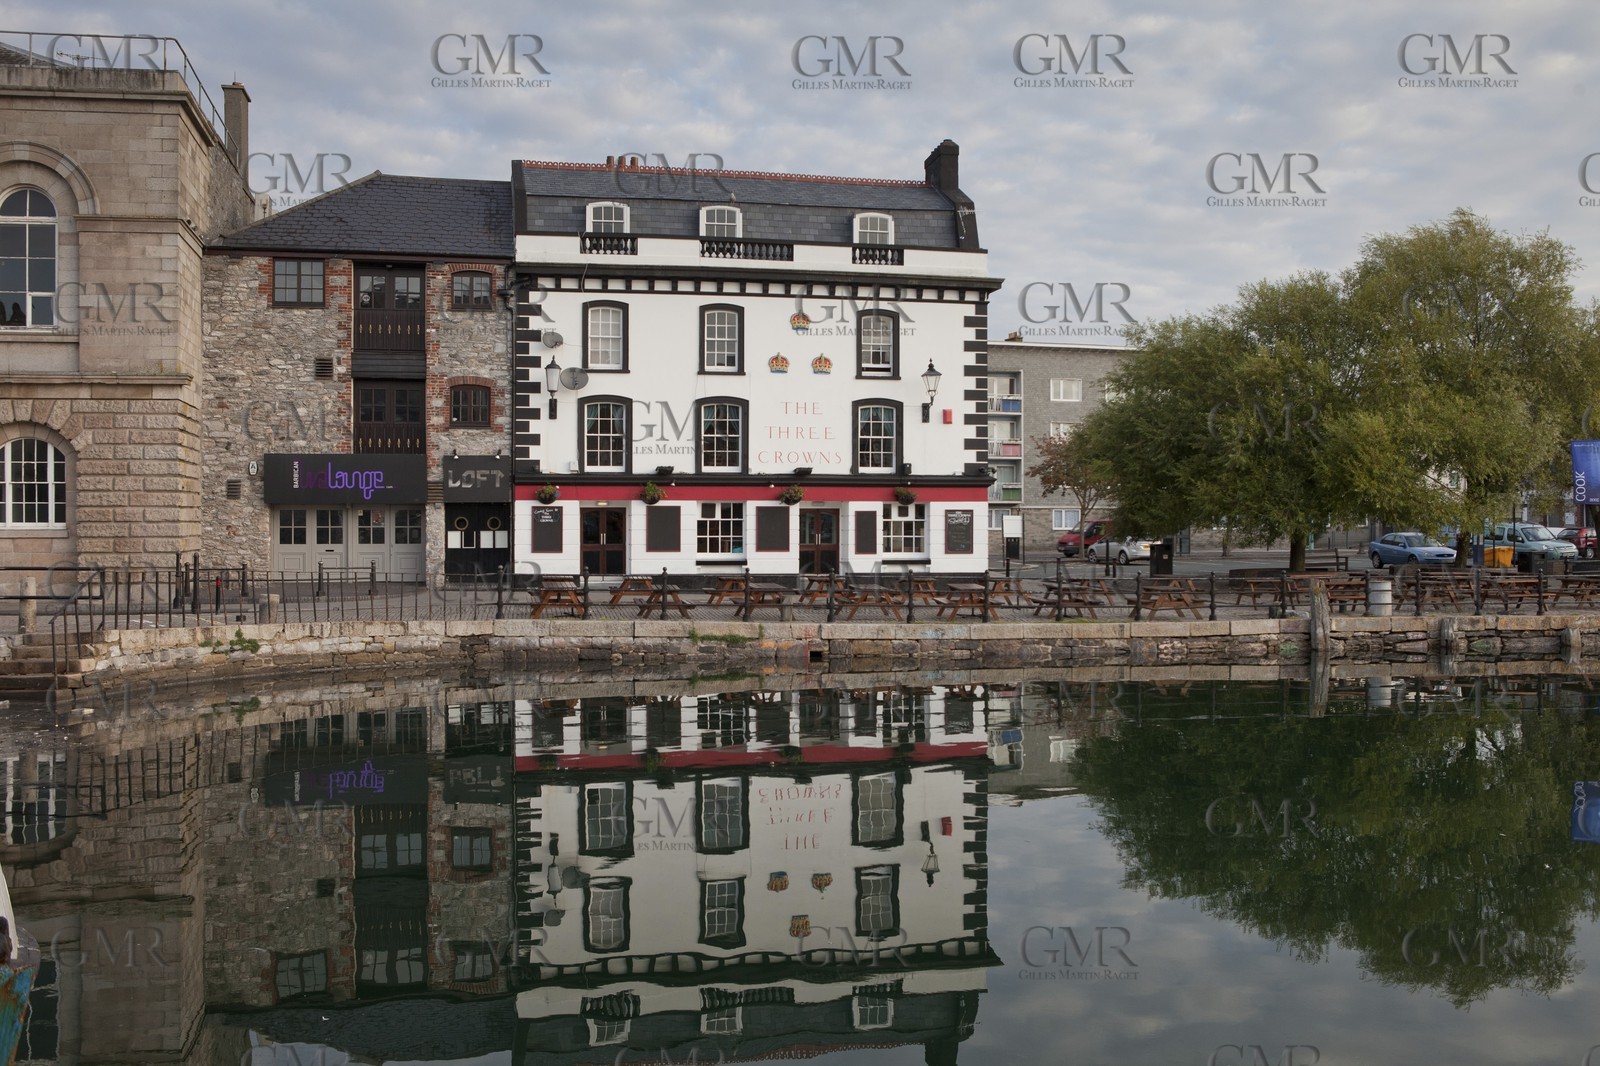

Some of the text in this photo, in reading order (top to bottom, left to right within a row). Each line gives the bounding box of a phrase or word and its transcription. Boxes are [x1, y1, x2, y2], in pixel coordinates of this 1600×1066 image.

[780, 401, 823, 415] THE
[764, 426, 836, 440] THREE
[758, 451, 842, 464] CROWNS
[448, 469, 504, 488] LOFT
[1575, 471, 1586, 502] COOK
